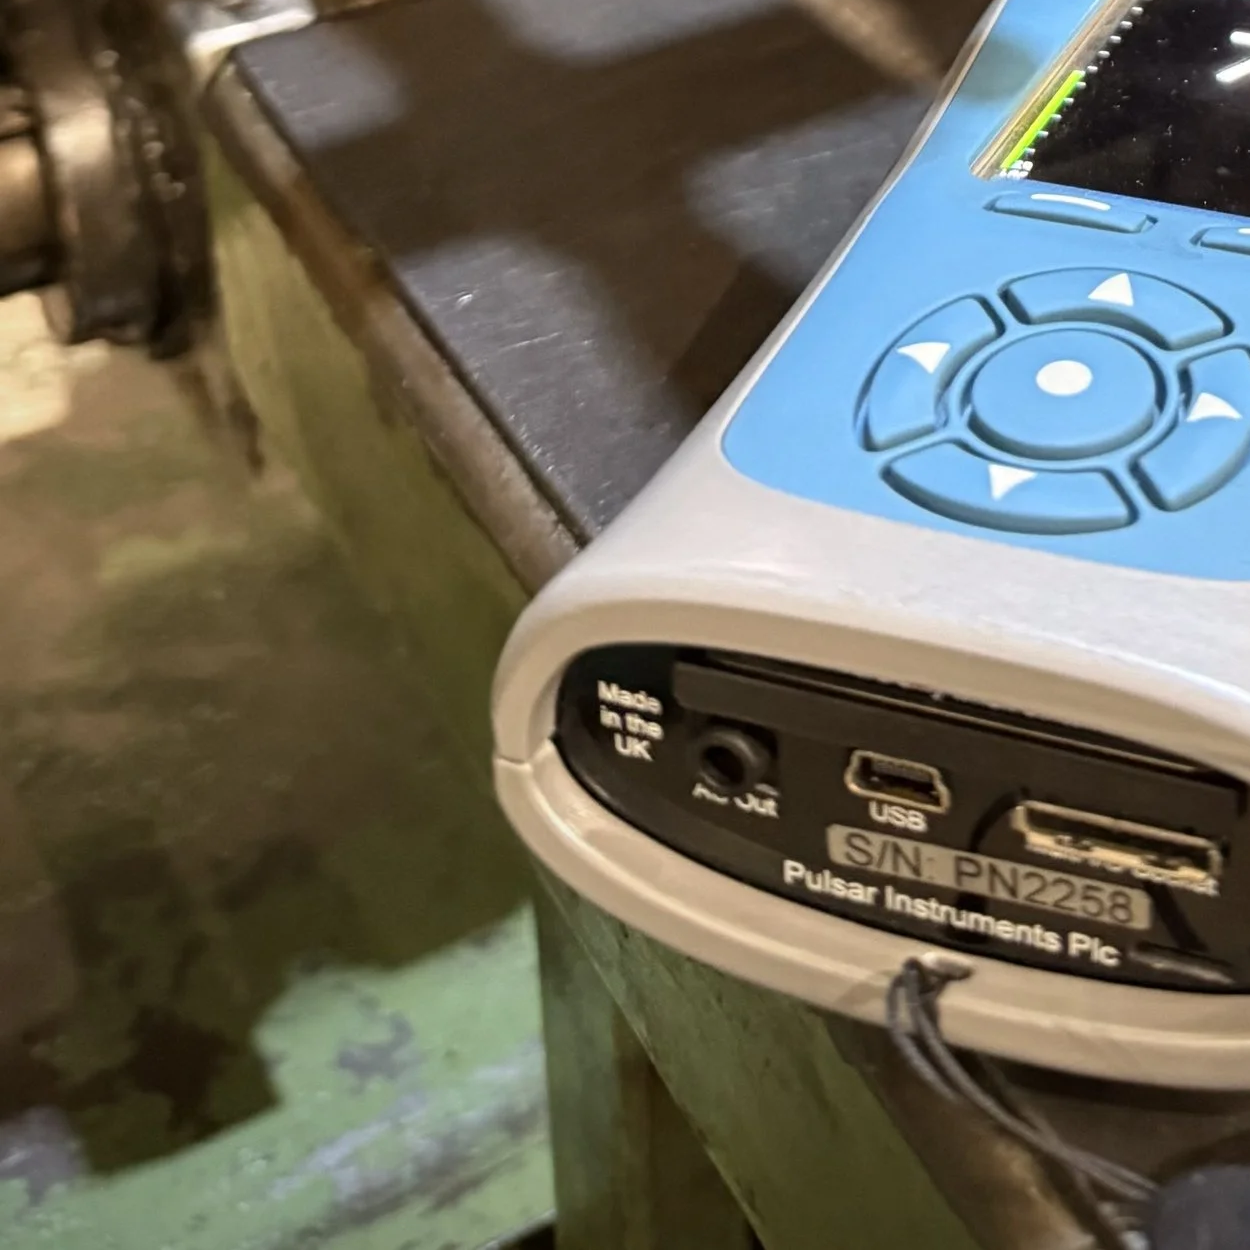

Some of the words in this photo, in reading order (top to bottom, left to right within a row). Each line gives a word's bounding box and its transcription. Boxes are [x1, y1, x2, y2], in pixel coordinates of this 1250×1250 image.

[597, 680, 663, 716] Made
[600, 705, 622, 730] in
[625, 713, 664, 740] the
[614, 733, 654, 761] UK
[868, 801, 928, 832] USB
[844, 832, 936, 882] S/N:
[953, 856, 1133, 924] PN2258
[783, 860, 879, 904] Pulsar
[885, 884, 1062, 952] Instruments
[1068, 931, 1122, 967] Plc
